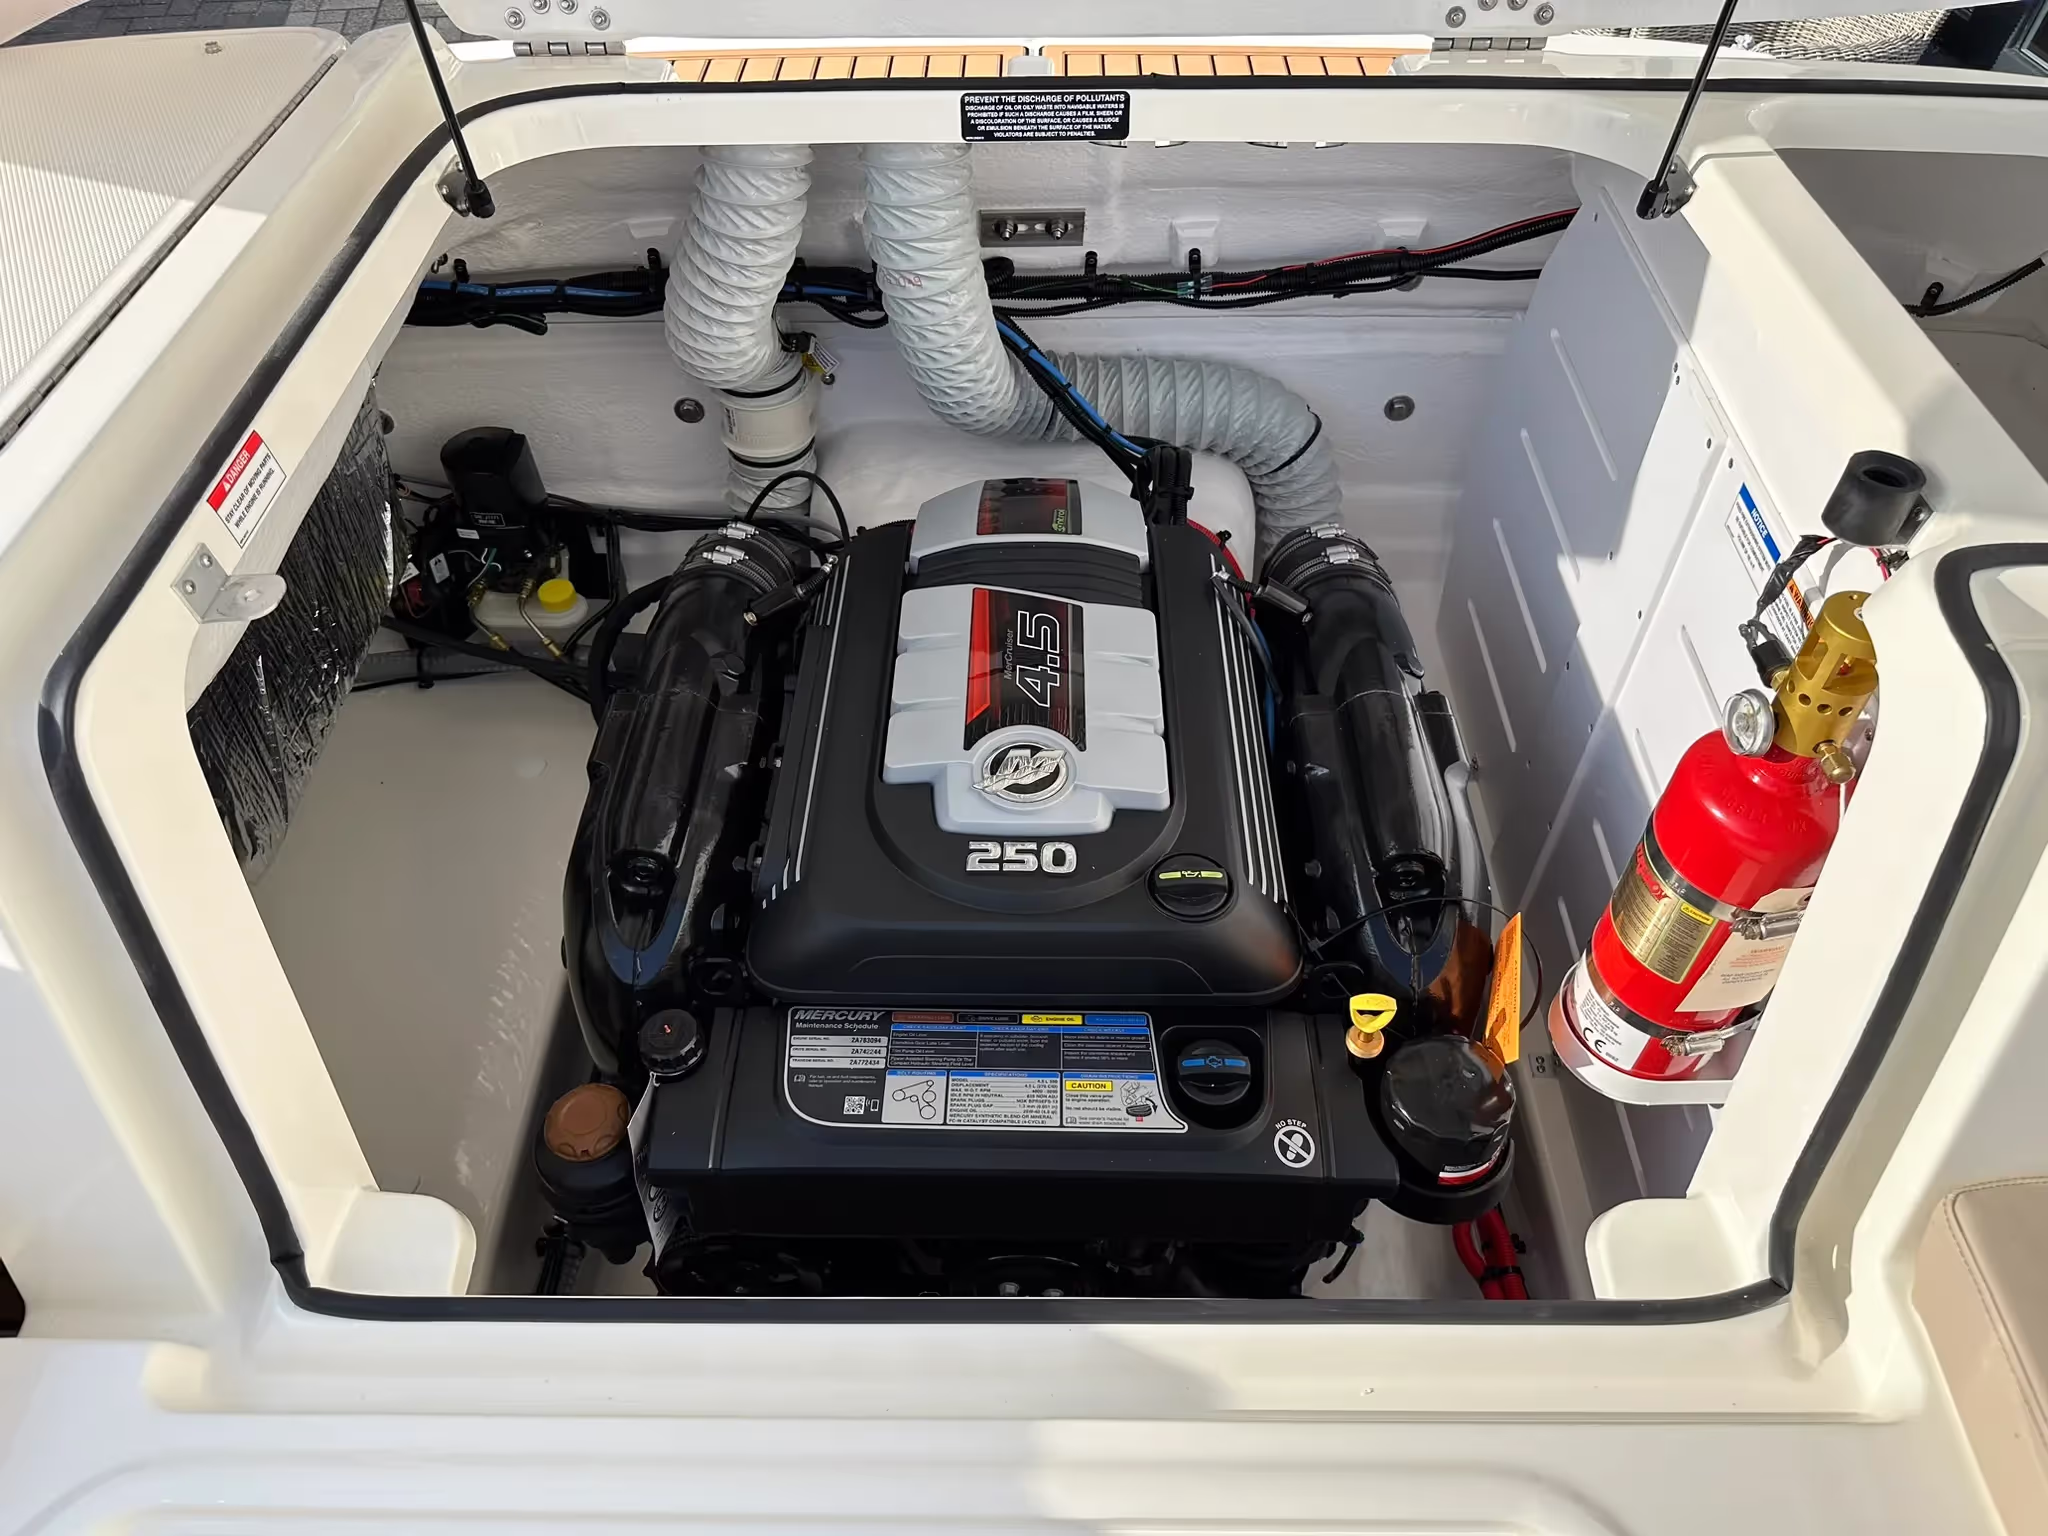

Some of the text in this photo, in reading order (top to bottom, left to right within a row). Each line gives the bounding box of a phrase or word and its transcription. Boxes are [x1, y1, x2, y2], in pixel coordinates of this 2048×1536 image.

[1001, 95, 1016, 103] THE
[1076, 94, 1125, 102] POLLUTANTS
[226, 449, 250, 483] DANGER
[224, 452, 271, 523] STAY CLEAR OF MOVING PARTS
[234, 510, 246, 528] WHILE
[244, 491, 259, 513] ENGINE
[1751, 508, 1768, 538] NOTICE
[1004, 628, 1014, 680] MerCruiser
[1016, 610, 1060, 708] 4.5
[966, 841, 1077, 874] 250
[794, 1010, 885, 1020] MERCURY
[1275, 1119, 1307, 1129] NO STEP
